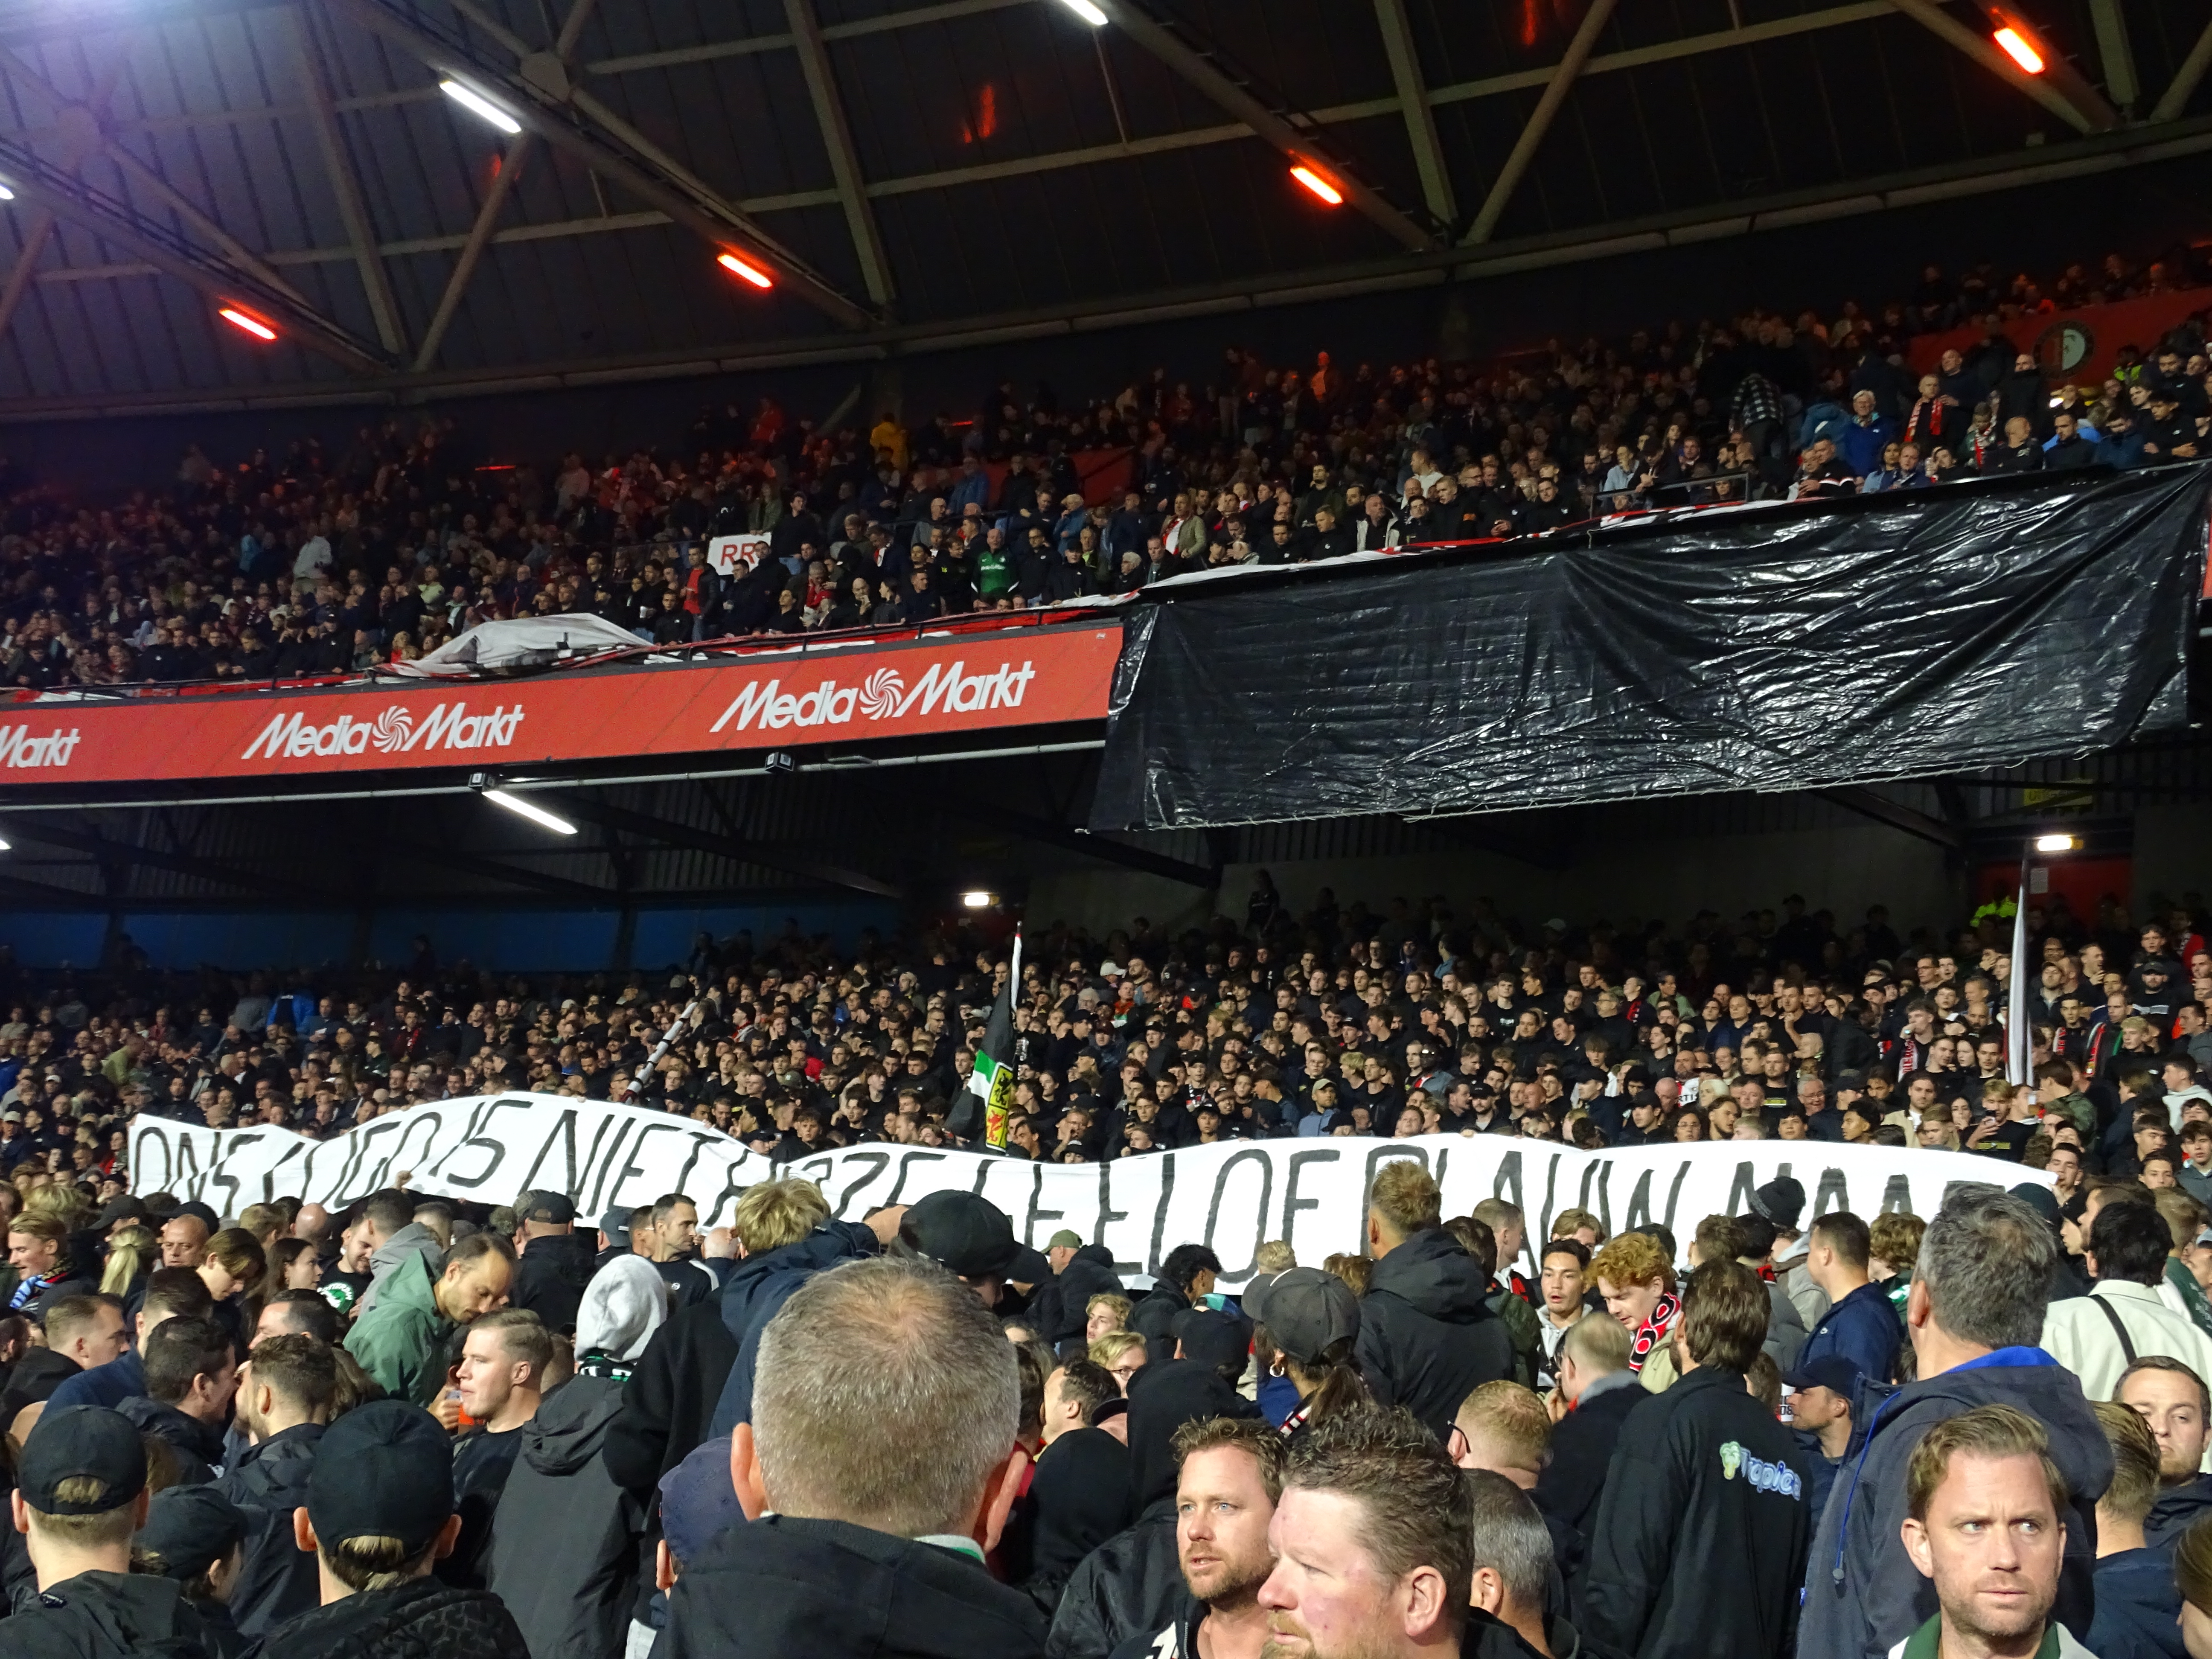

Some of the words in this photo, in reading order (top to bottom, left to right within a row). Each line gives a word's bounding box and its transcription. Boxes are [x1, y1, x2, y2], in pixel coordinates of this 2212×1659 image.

[710, 680, 858, 733] Media
[892, 661, 1035, 718] Markt
[0, 724, 81, 768] Markt
[241, 712, 372, 759] Media
[401, 702, 525, 751] Markt
[428, 1099, 533, 1188] IS
[517, 1109, 725, 1217] NIET
[1204, 1148, 1341, 1282] OF
[1726, 1161, 2006, 1222] MAA
